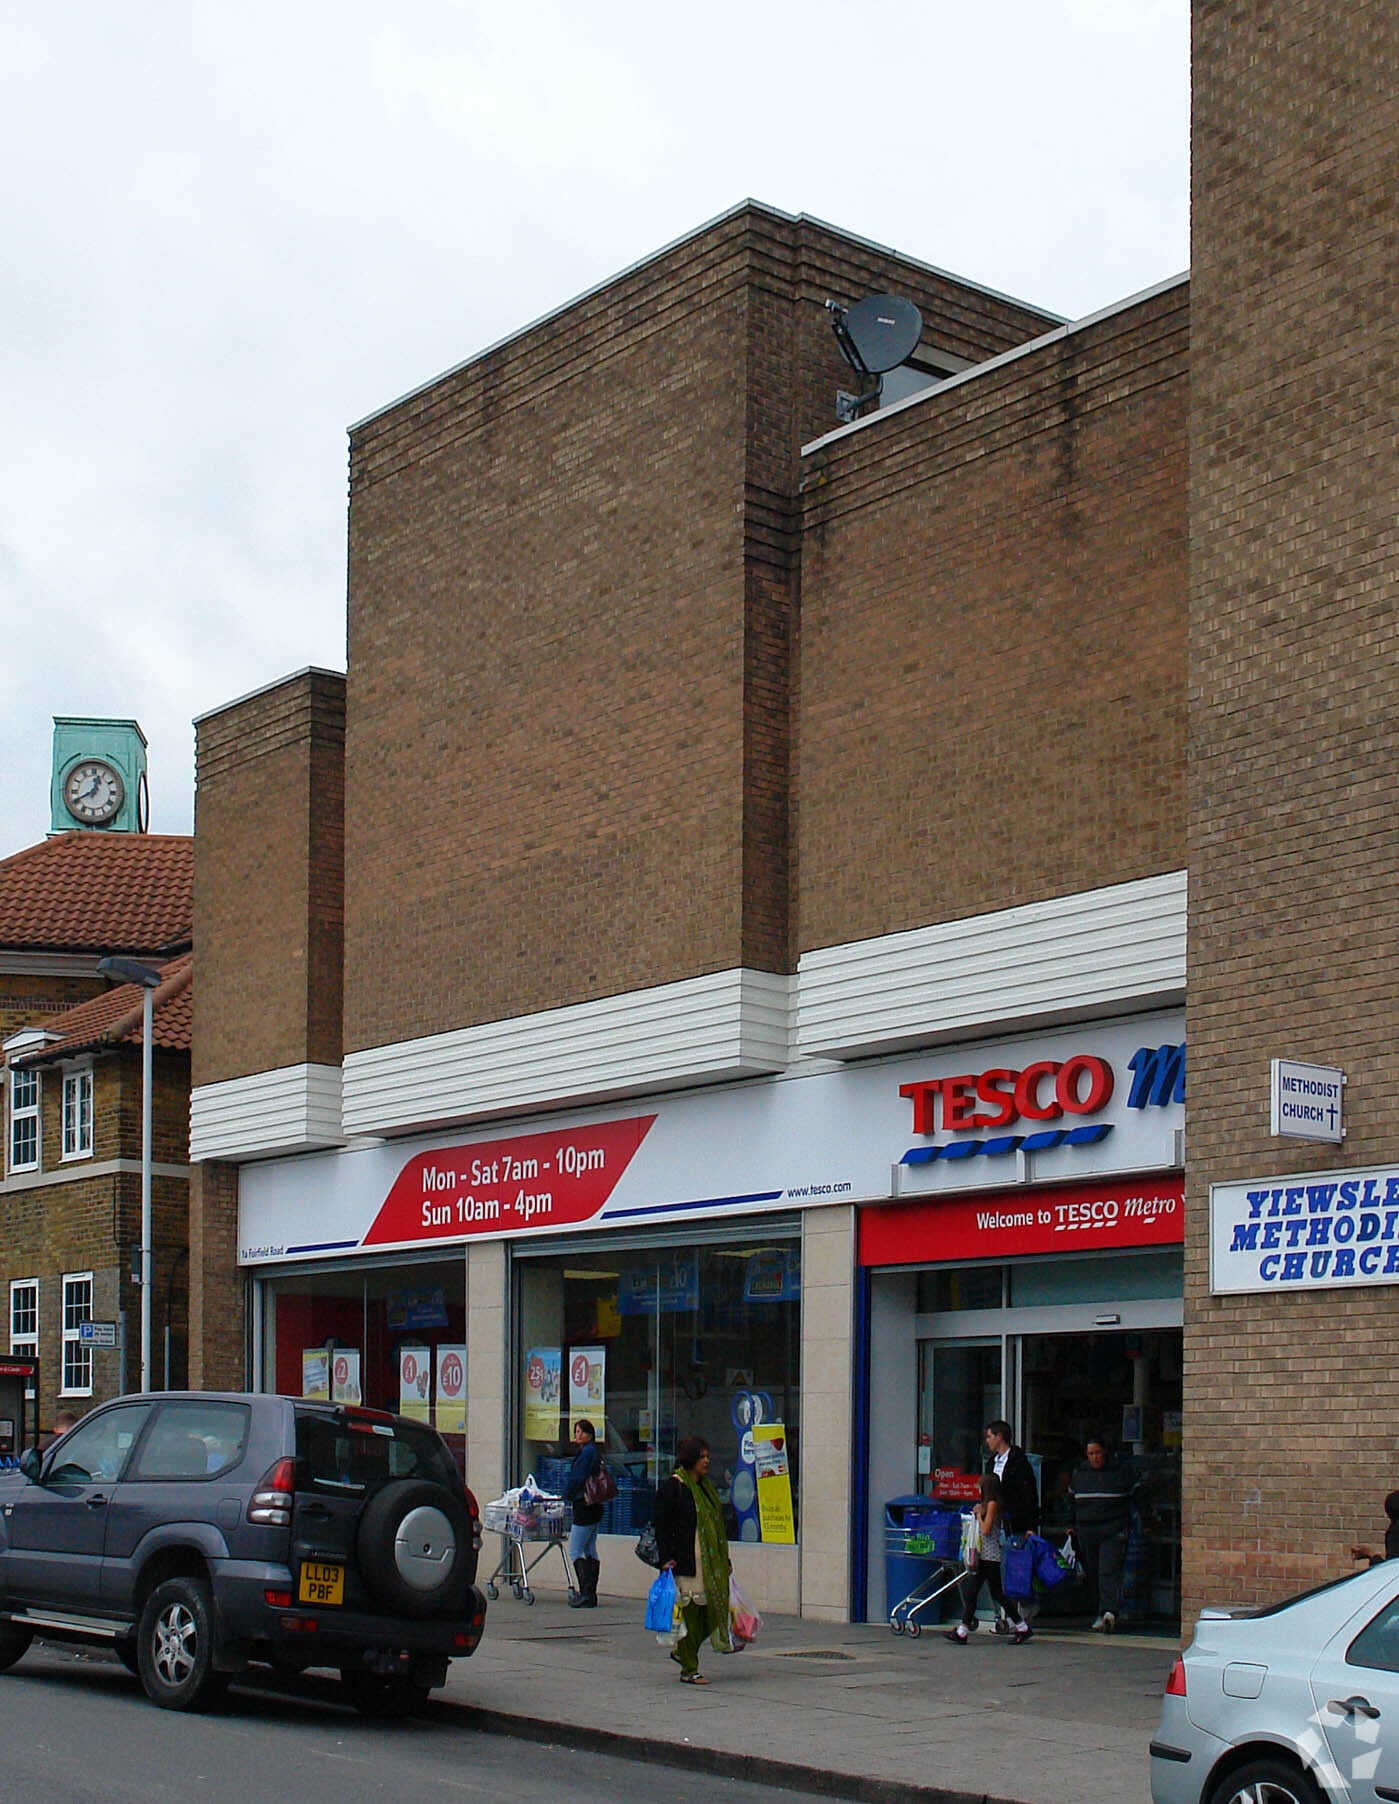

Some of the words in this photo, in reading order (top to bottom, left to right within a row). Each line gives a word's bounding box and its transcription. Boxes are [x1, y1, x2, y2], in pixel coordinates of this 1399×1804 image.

[899, 1054, 1115, 1135] TESCO
[1282, 1076, 1339, 1098] METHODIST
[1282, 1102, 1324, 1122] CHURCH
[422, 1166, 456, 1193] Mon
[471, 1160, 499, 1186] Sat
[502, 1156, 538, 1182] 7am
[556, 1146, 605, 1178] 10pm
[787, 1182, 851, 1198] www.tesco.com
[421, 1201, 451, 1227] Sun
[456, 1195, 499, 1222] 10am
[514, 1189, 552, 1221] 4pm
[976, 1213, 1033, 1229] Welcome
[1037, 1209, 1051, 1224] to
[1055, 1200, 1119, 1223] TESCO
[1124, 1195, 1176, 1217] Metro
[249, 1247, 269, 1258] Fairfield
[270, 1245, 284, 1255] Road
[1260, 1245, 1399, 1281] CHURCH
[84, 1326, 92, 1338] P
[442, 1365, 461, 1387] £10
[574, 1360, 586, 1382] £1
[934, 1468, 954, 1479] Open
[305, 1564, 340, 1583] LL03
[308, 1583, 335, 1600] PBF
